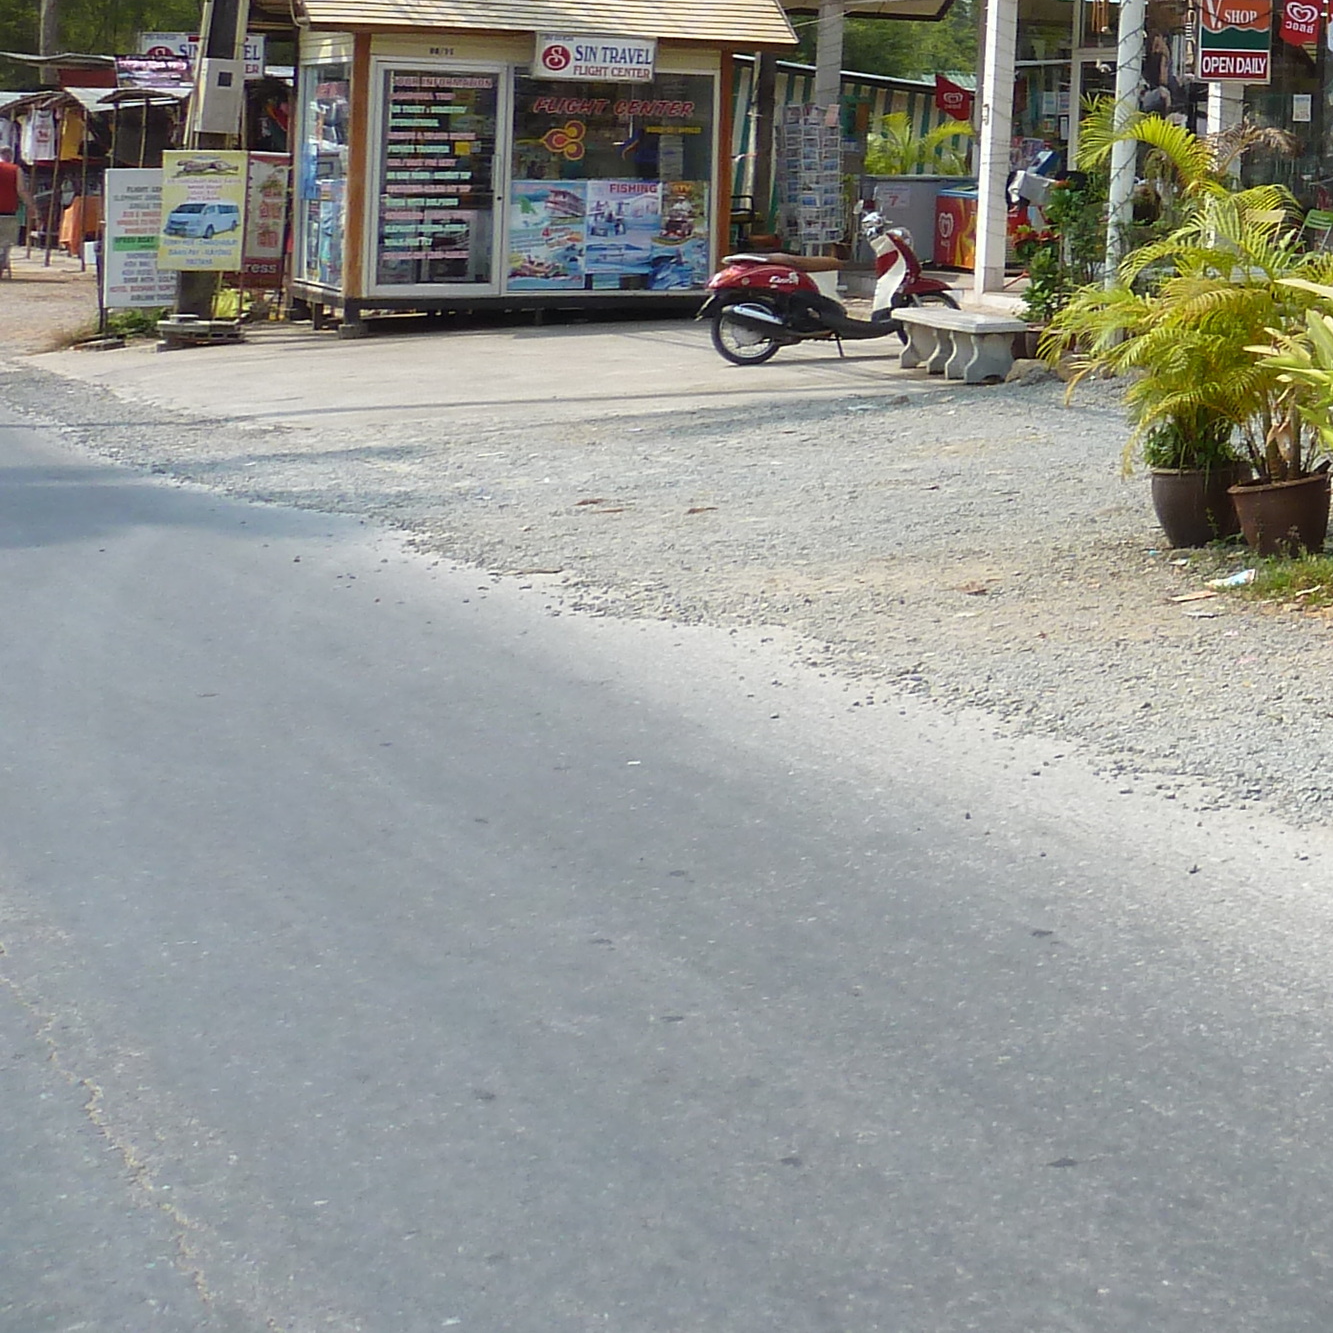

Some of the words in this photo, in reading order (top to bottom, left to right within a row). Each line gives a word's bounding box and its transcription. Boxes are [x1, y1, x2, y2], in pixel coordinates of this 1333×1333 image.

[575, 45, 599, 62] SIN
[601, 46, 652, 65] TRAVEL
[573, 65, 609, 77] FLIGHT
[611, 67, 650, 79] CENTER
[1203, 57, 1235, 74] OPEN
[1236, 57, 1266, 75] DAILY
[533, 97, 611, 114] FLIGHT
[614, 99, 695, 117] CENTER
[609, 184, 658, 194] FISHING
